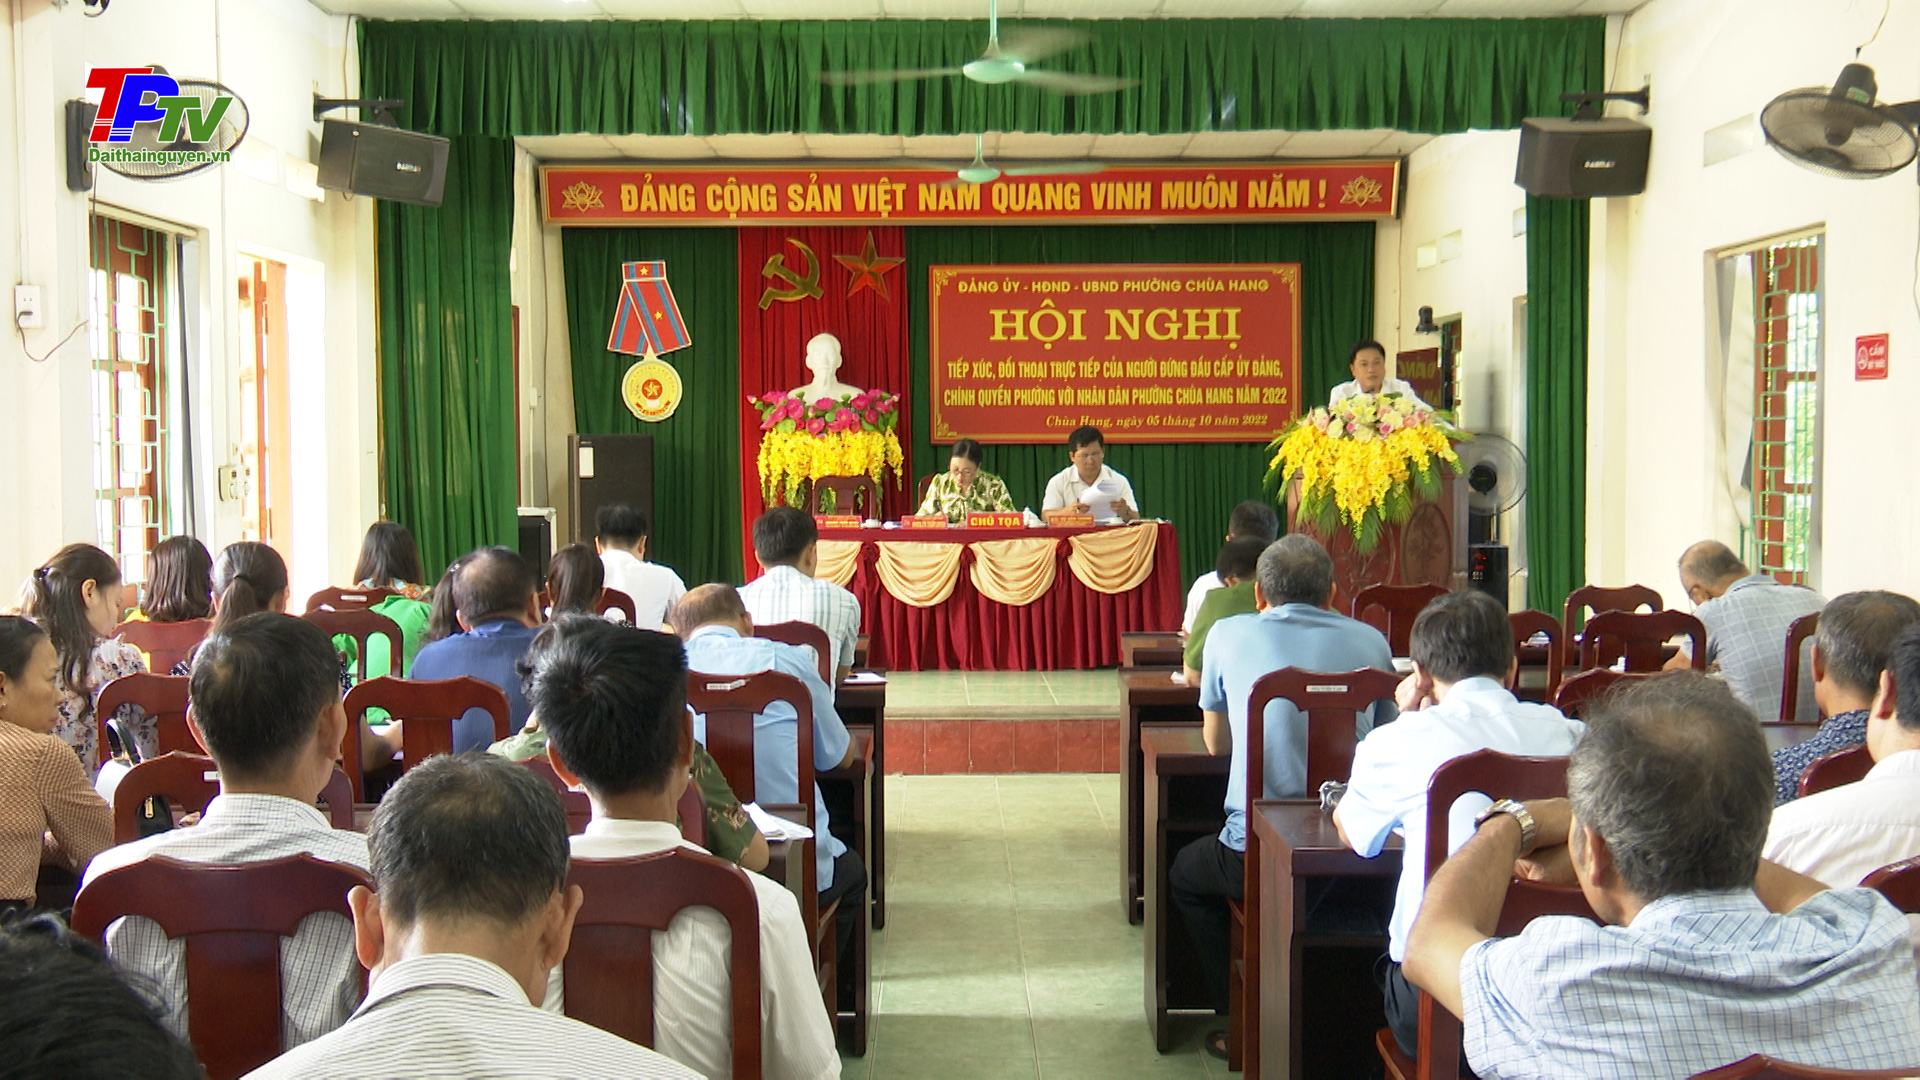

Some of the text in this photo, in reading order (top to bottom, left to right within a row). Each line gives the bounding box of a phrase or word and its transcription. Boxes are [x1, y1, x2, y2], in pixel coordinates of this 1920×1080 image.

[620, 173, 1327, 220] ĐẢNG CỘNG SẢN VIỆT NAM QUANG VINH MUÔN NĂM !
[958, 277, 999, 293] ĐẢNG
[1002, 277, 1020, 293] ỦY
[1032, 280, 1071, 293] HĐND
[1082, 280, 1120, 293] UBND
[1122, 277, 1182, 292] PHƯỜNG
[1186, 277, 1225, 292] CHÙA
[1228, 279, 1270, 292] HANG
[989, 298, 1242, 350] HỘI NGHỊ
[947, 356, 970, 378] TIẾP
[972, 358, 996, 380] XÚC,
[998, 356, 1016, 378] ĐỐI
[1018, 361, 1048, 382] THOẠI
[1050, 360, 1076, 382] TRỰC
[1078, 356, 1100, 378] TIẾP
[1102, 356, 1124, 378] CỦA
[1126, 357, 1158, 378] NGƯỜI
[1160, 357, 1188, 378] ĐỨNG
[1214, 354, 1234, 378] CẤP
[1236, 354, 1250, 378] ỦY
[1252, 354, 1284, 379] ĐẢNG,
[944, 386, 976, 406] CHÍNH
[1014, 386, 1056, 406] PHƯỜNG
[1077, 385, 1106, 406] NHÂN
[1108, 385, 1130, 406] DÂN
[1132, 384, 1174, 405] PHƯỜNG
[1176, 384, 1203, 404] CHÙA
[1205, 387, 1234, 404] HANG
[1236, 384, 1260, 404] NĂM
[1262, 387, 1288, 404] 2022
[1080, 415, 1113, 428] Hang,
[1116, 415, 1144, 428] ngày
[1146, 414, 1160, 426] 05
[1162, 414, 1196, 428] tháng
[1199, 414, 1212, 426] 10
[1214, 415, 1240, 426] năm
[1242, 414, 1268, 426] 2022
[970, 514, 1020, 528] CHỦ TỌA
